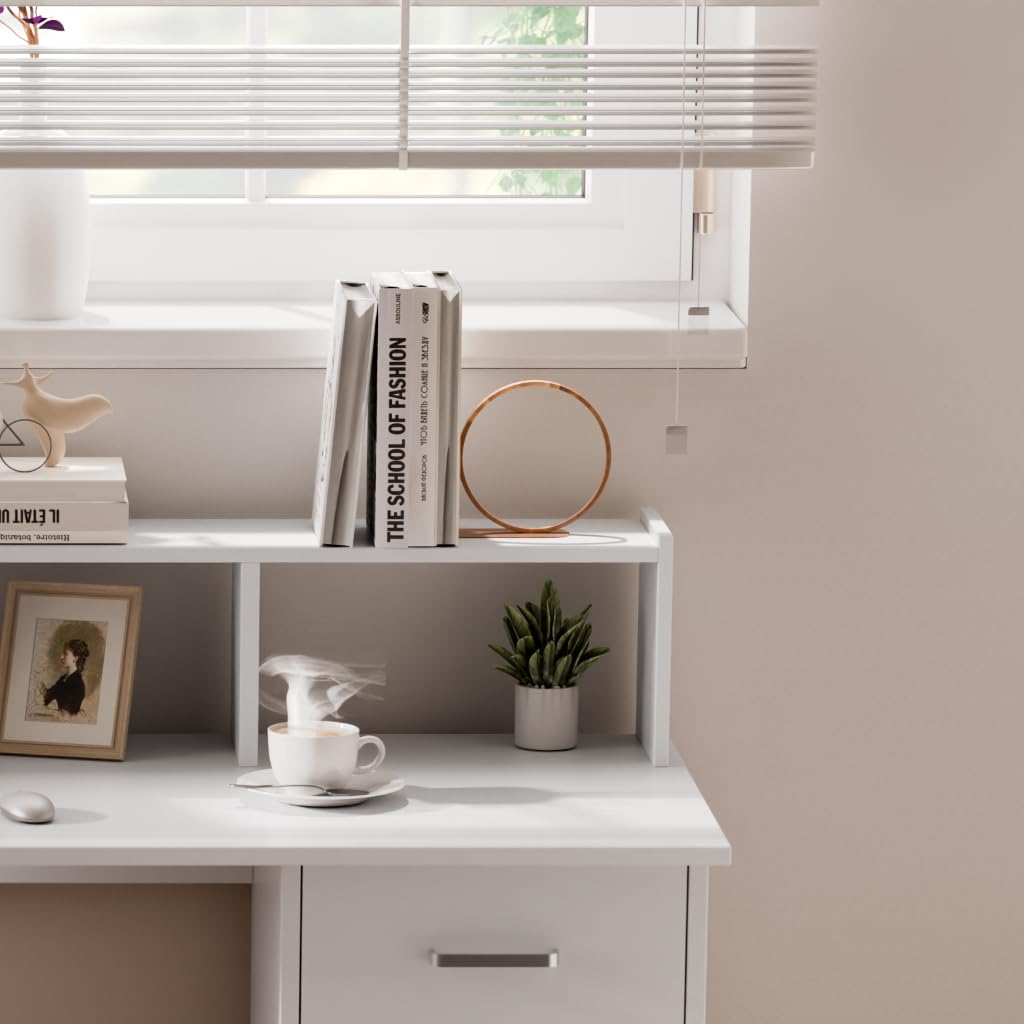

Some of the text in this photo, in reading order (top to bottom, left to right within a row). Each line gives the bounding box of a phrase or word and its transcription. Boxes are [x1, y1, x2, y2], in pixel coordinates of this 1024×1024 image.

[394, 292, 402, 325] ASSOULINE
[387, 337, 407, 543] THE SCHOOL OF FASHION
[13, 508, 47, 527] ÉTAIT
[49, 508, 60, 524] IL
[33, 533, 71, 542] Histoire,
